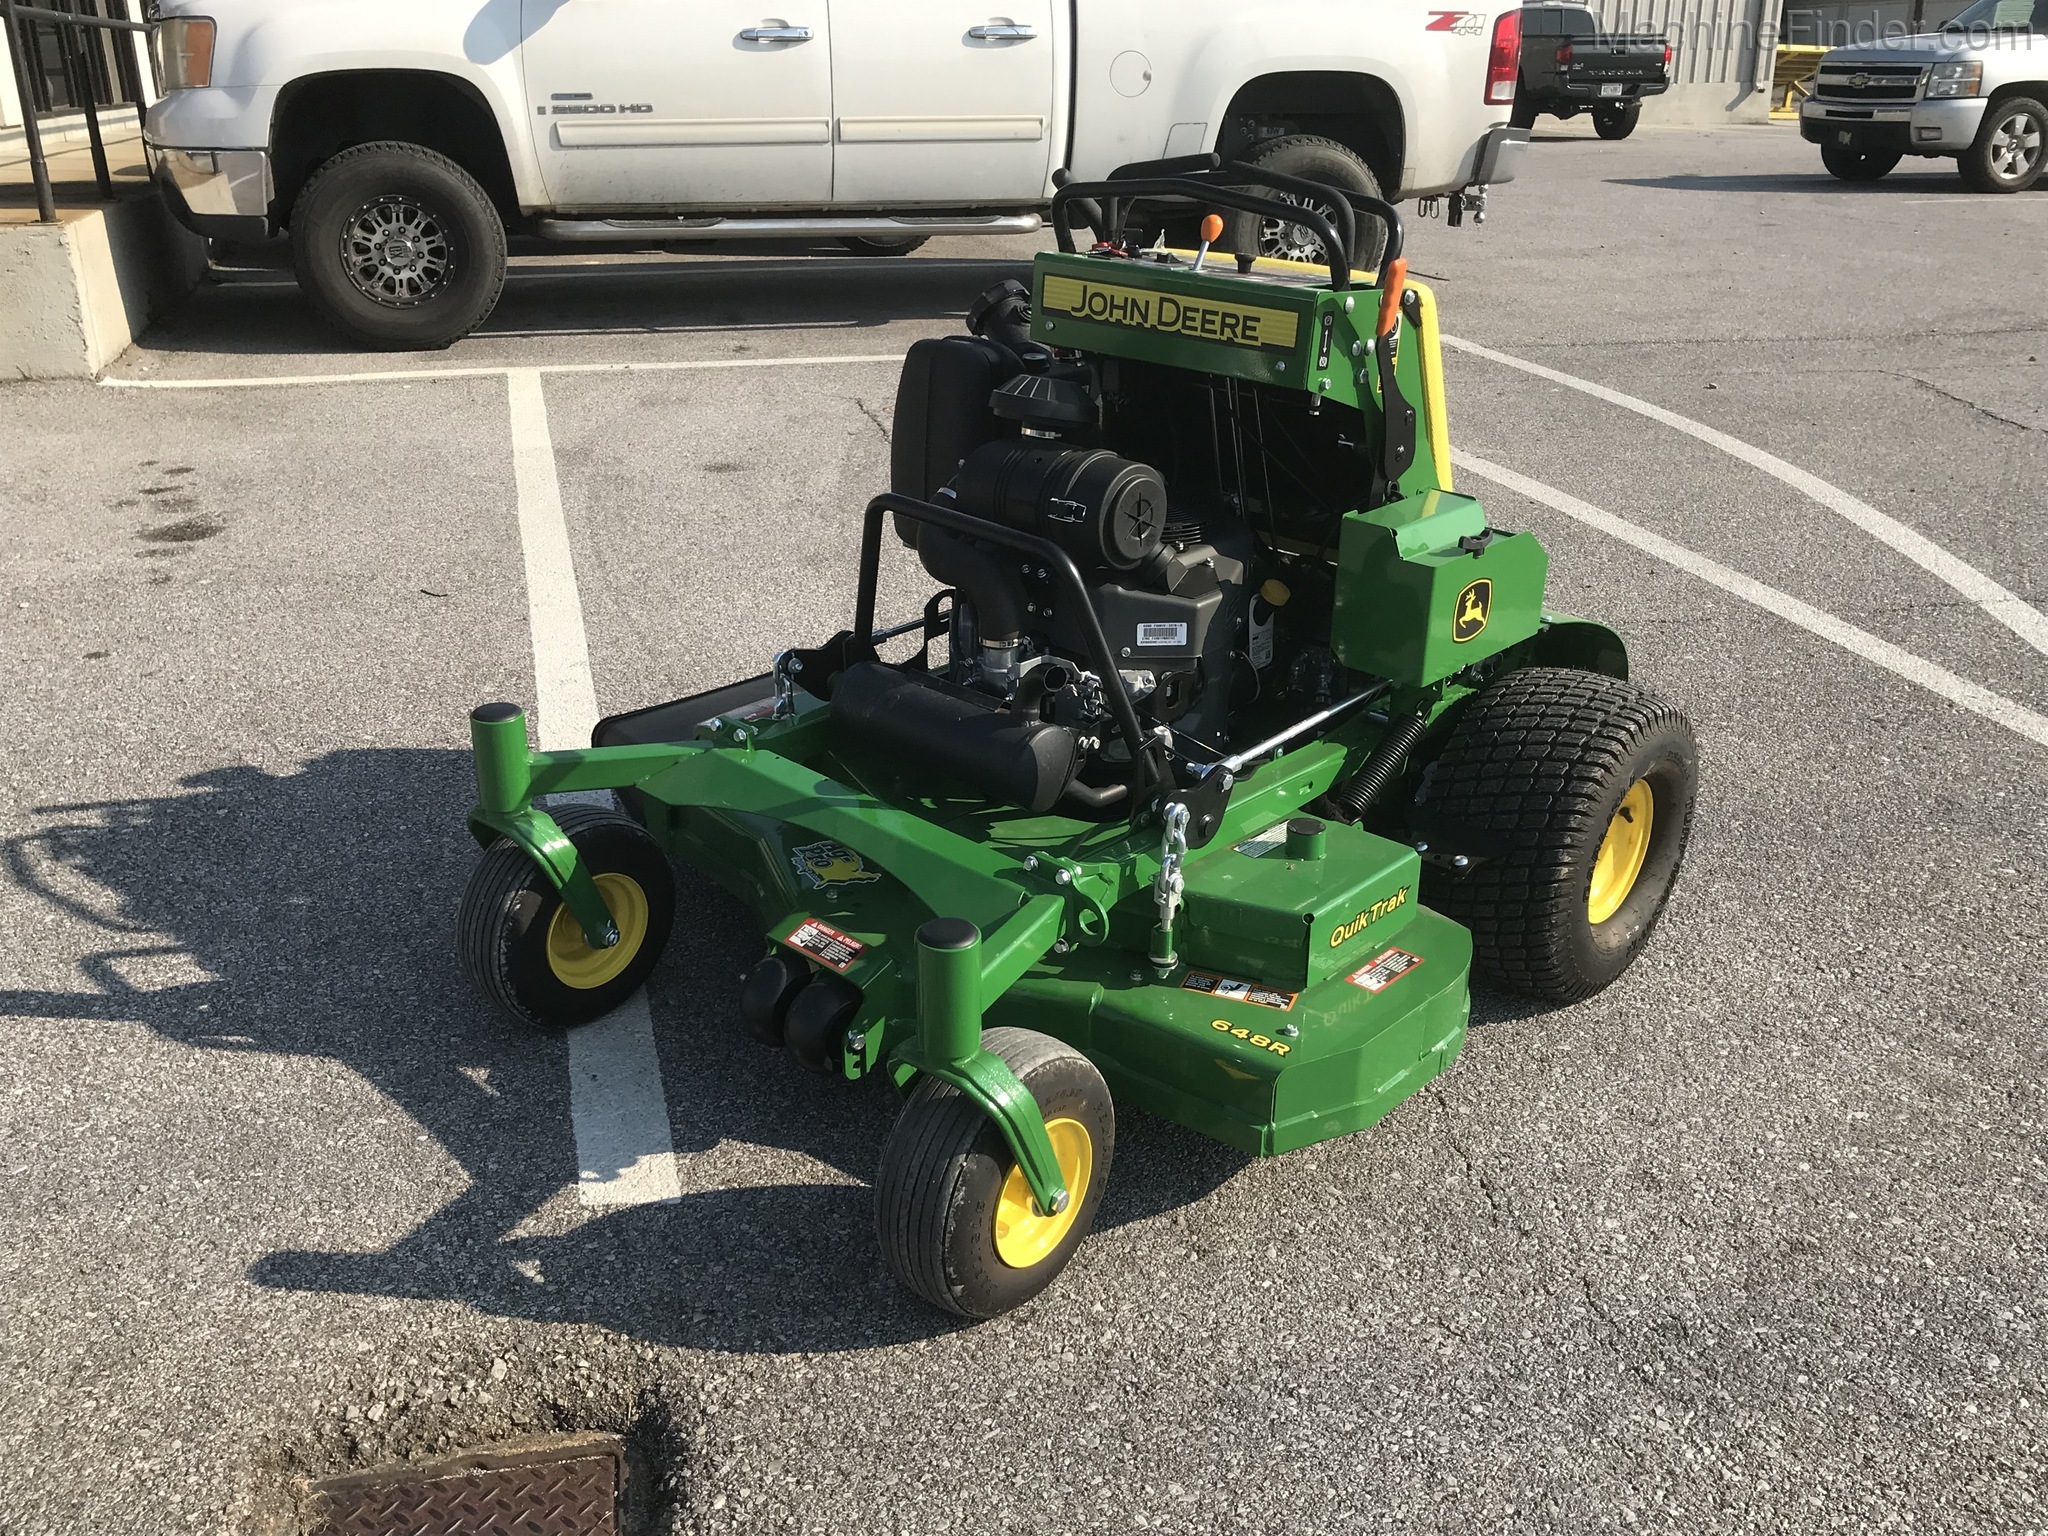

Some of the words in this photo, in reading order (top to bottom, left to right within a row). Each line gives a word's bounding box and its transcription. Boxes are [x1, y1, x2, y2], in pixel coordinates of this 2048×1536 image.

[1071, 284, 1151, 325] JOHN
[1156, 295, 1263, 344] DEERE
[1210, 1019, 1293, 1058] 648R
